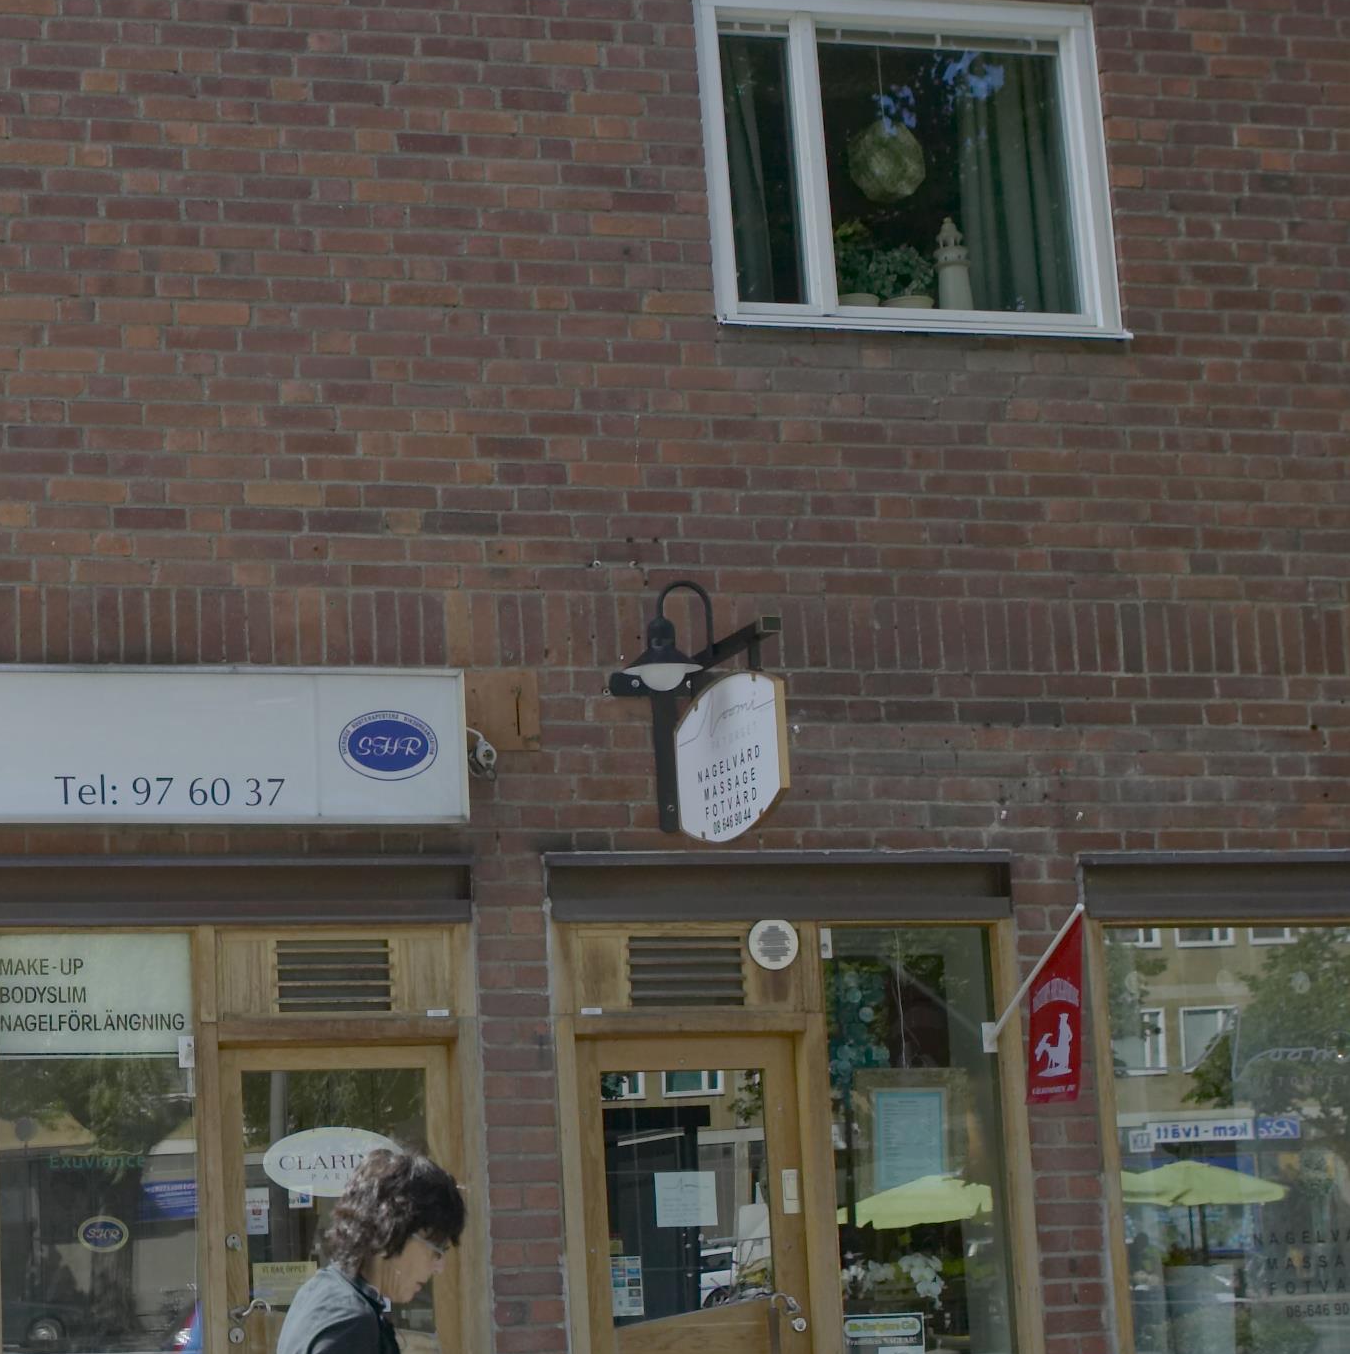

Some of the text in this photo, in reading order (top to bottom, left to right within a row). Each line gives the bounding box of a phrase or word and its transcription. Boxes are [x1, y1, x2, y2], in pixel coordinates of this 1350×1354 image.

[355, 736, 422, 757] SHR
[697, 744, 761, 783] NAGELVÅRD
[54, 773, 285, 807] Tel: 97 60 37
[704, 767, 757, 800] MASSAGE
[705, 787, 758, 818] FOTVÅRD
[0, 986, 87, 1004] BODYSLIM
[0, 1009, 185, 1032] NAGELFÖRLÄNGNING
[279, 1155, 364, 1170] CLARI
[311, 1173, 350, 1181] PARI
